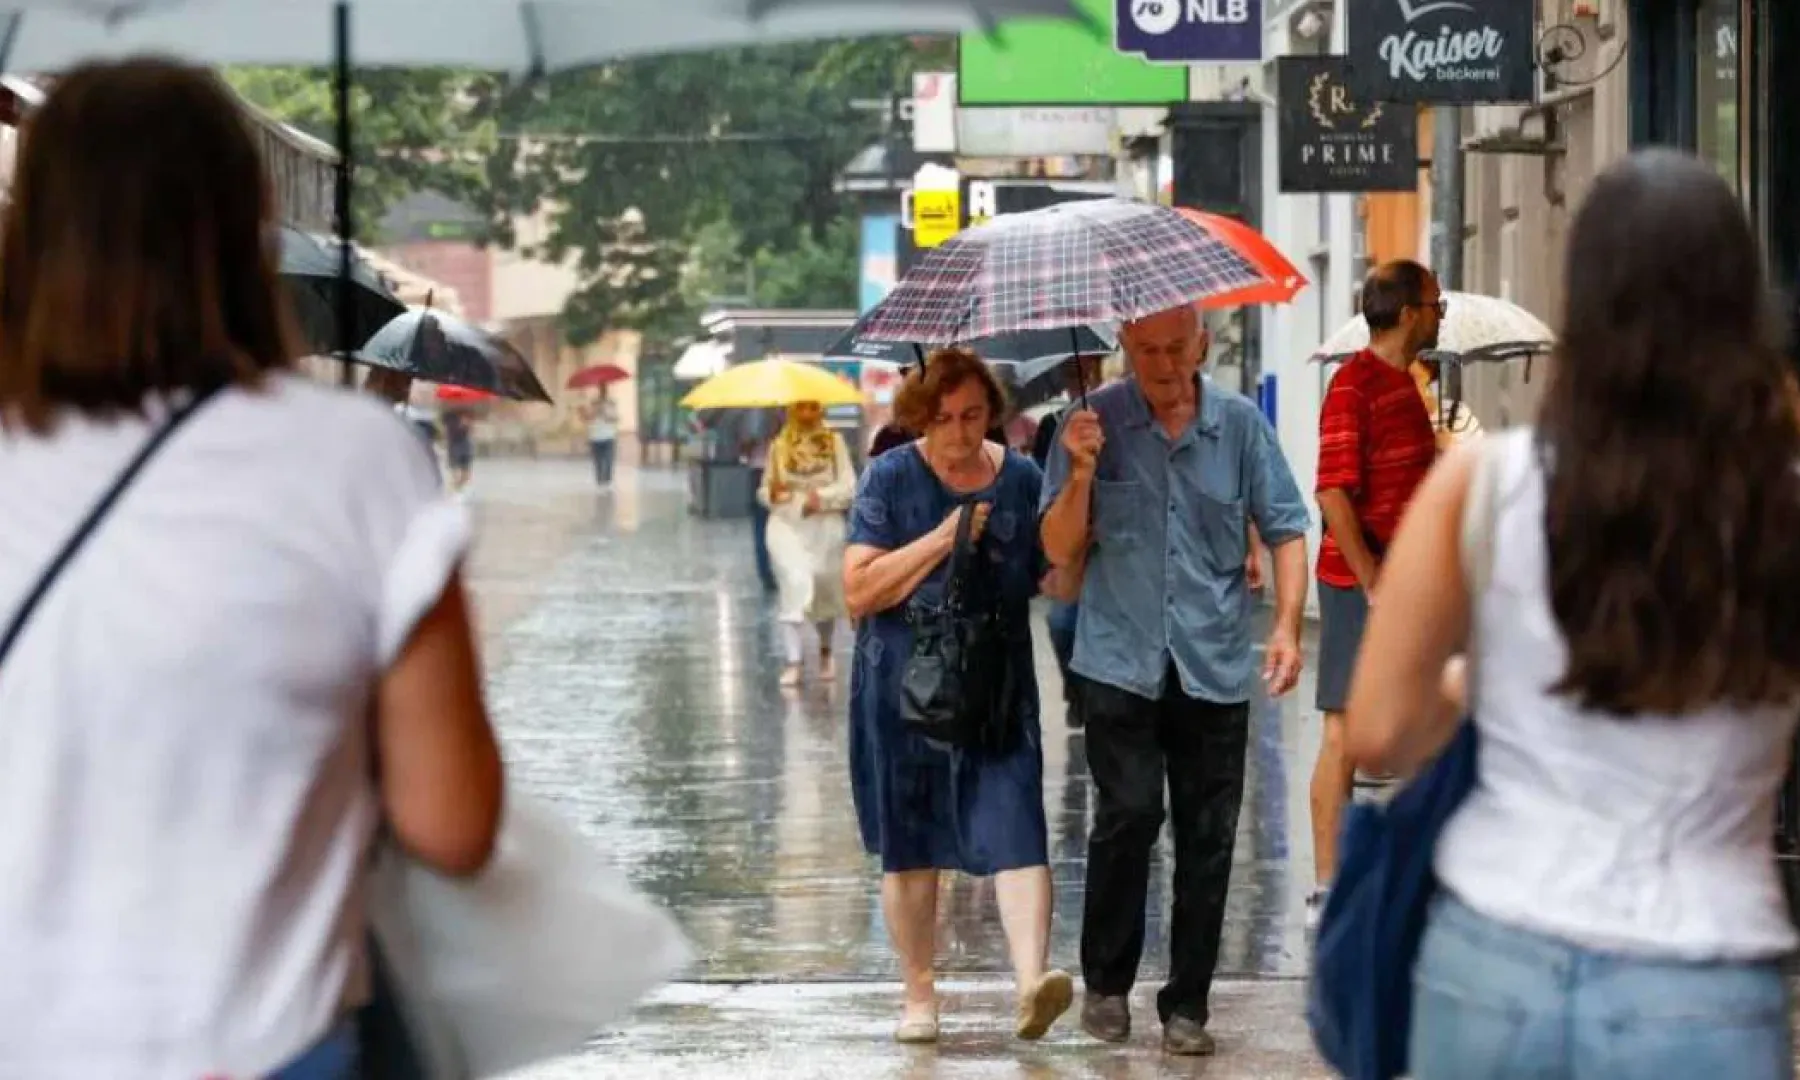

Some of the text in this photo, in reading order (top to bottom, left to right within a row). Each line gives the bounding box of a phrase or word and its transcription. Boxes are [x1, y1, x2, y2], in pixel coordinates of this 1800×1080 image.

[1186, 0, 1248, 23] NLB
[1379, 24, 1504, 81] Kaiser
[1302, 143, 1394, 164] PRIME
